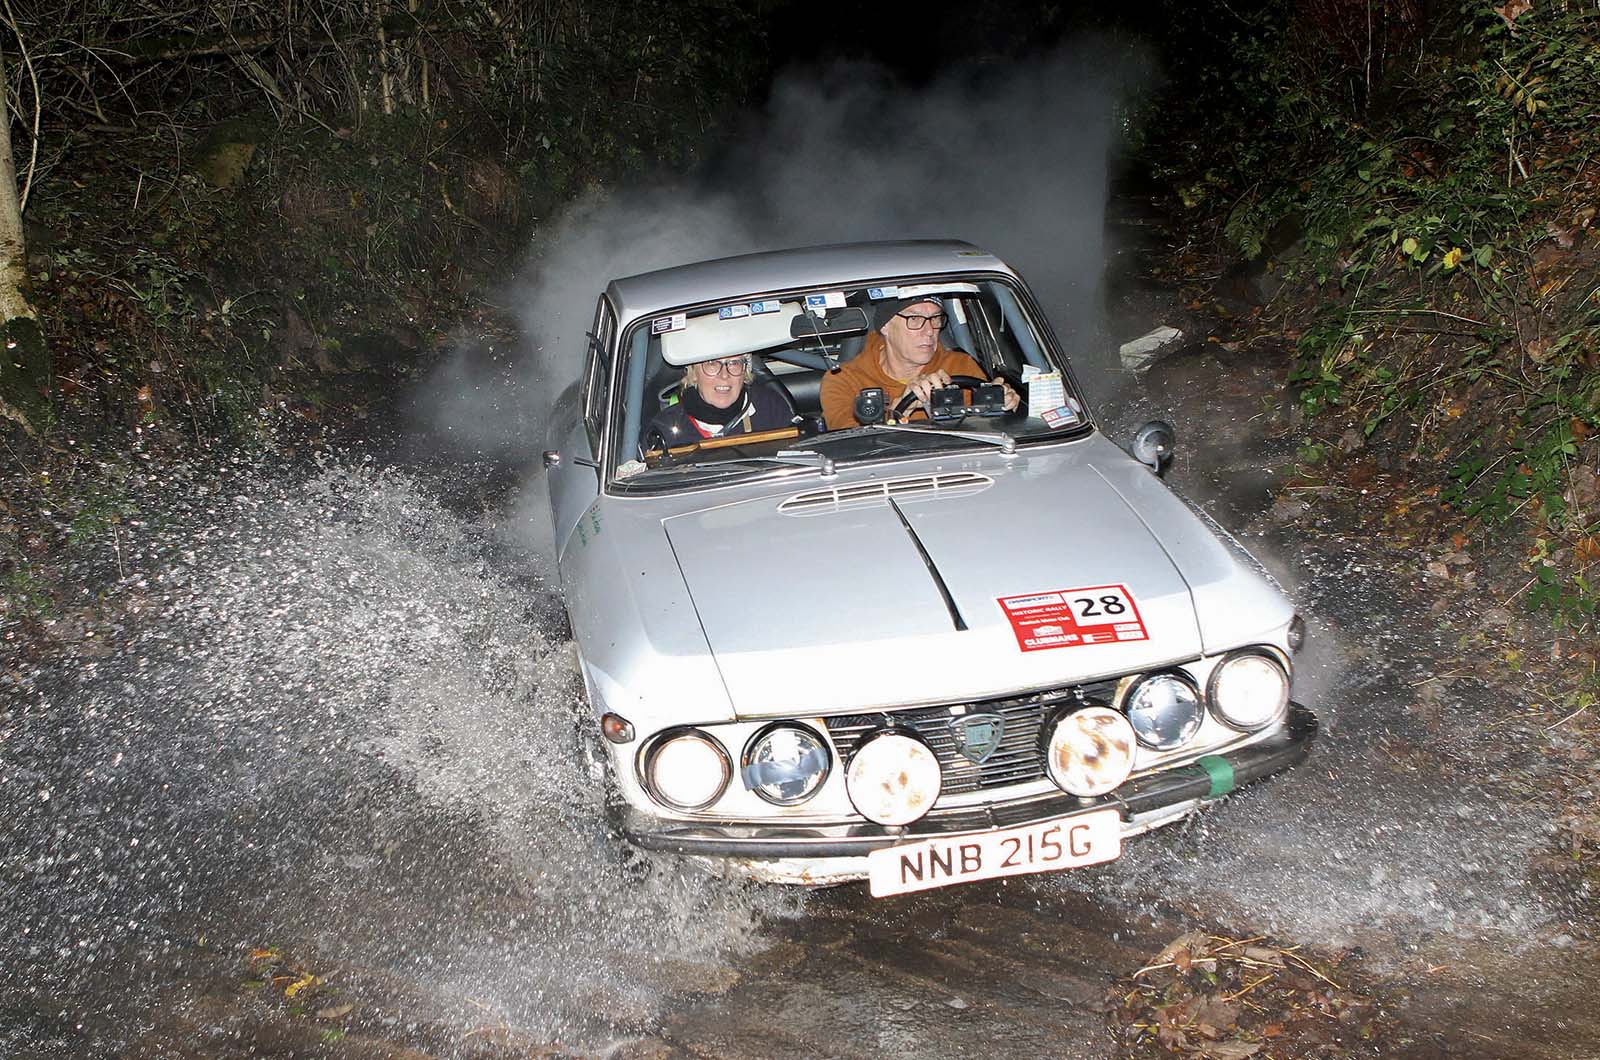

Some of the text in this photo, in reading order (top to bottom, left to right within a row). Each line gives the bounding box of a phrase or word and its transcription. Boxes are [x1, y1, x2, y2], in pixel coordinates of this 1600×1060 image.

[1011, 608, 1045, 617] HISTORIC
[1045, 604, 1068, 612] RALLY
[1074, 595, 1125, 617] 28
[1024, 634, 1079, 645] CLUBMANS
[900, 824, 1092, 884] NNB 215G
